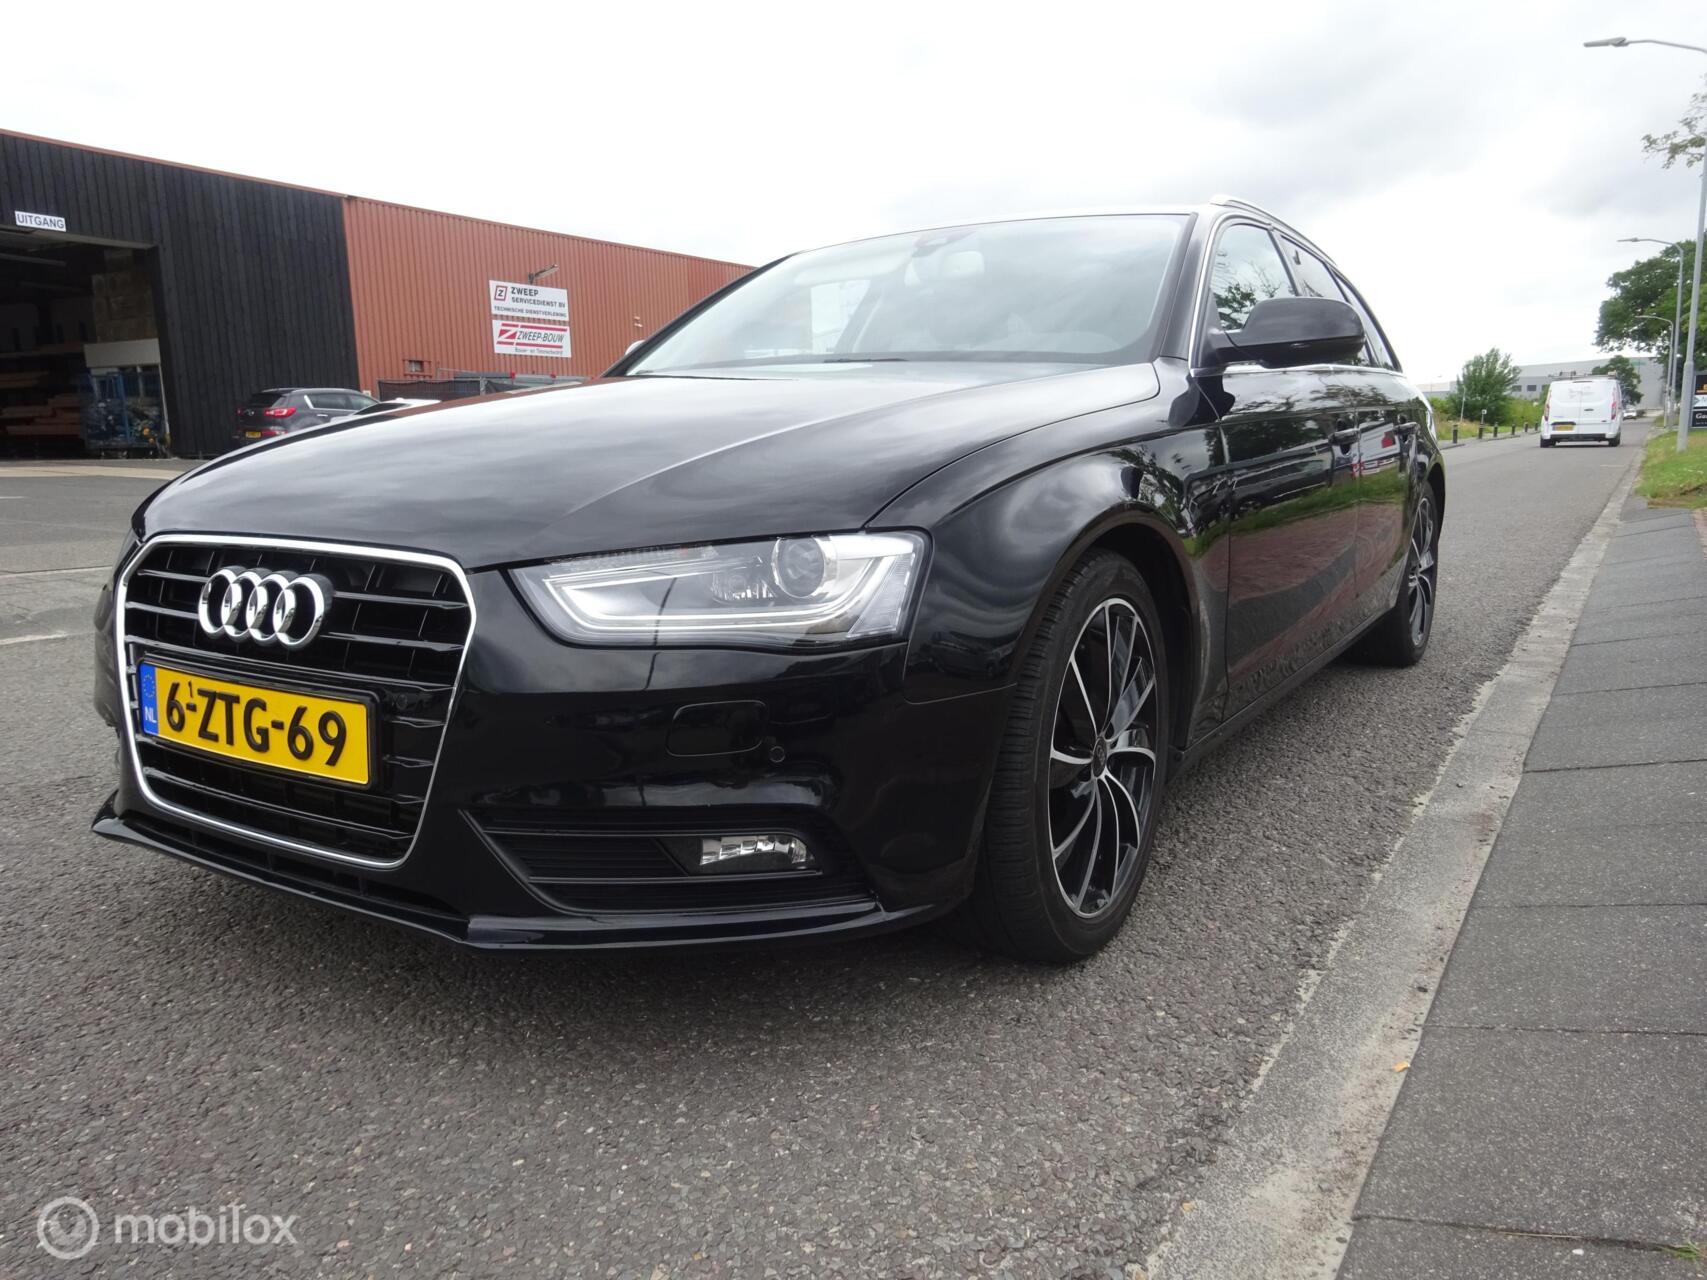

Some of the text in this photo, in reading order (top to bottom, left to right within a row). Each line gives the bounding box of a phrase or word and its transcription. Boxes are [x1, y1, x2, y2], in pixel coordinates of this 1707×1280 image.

[17, 213, 65, 229] UITGANG
[511, 287, 538, 296] ZWEEP
[511, 296, 557, 307] SERVICEDIENST
[517, 331, 564, 342] ZWEEP-BOUW
[144, 705, 157, 723] NL
[166, 682, 347, 767] 6-ZTG-69
